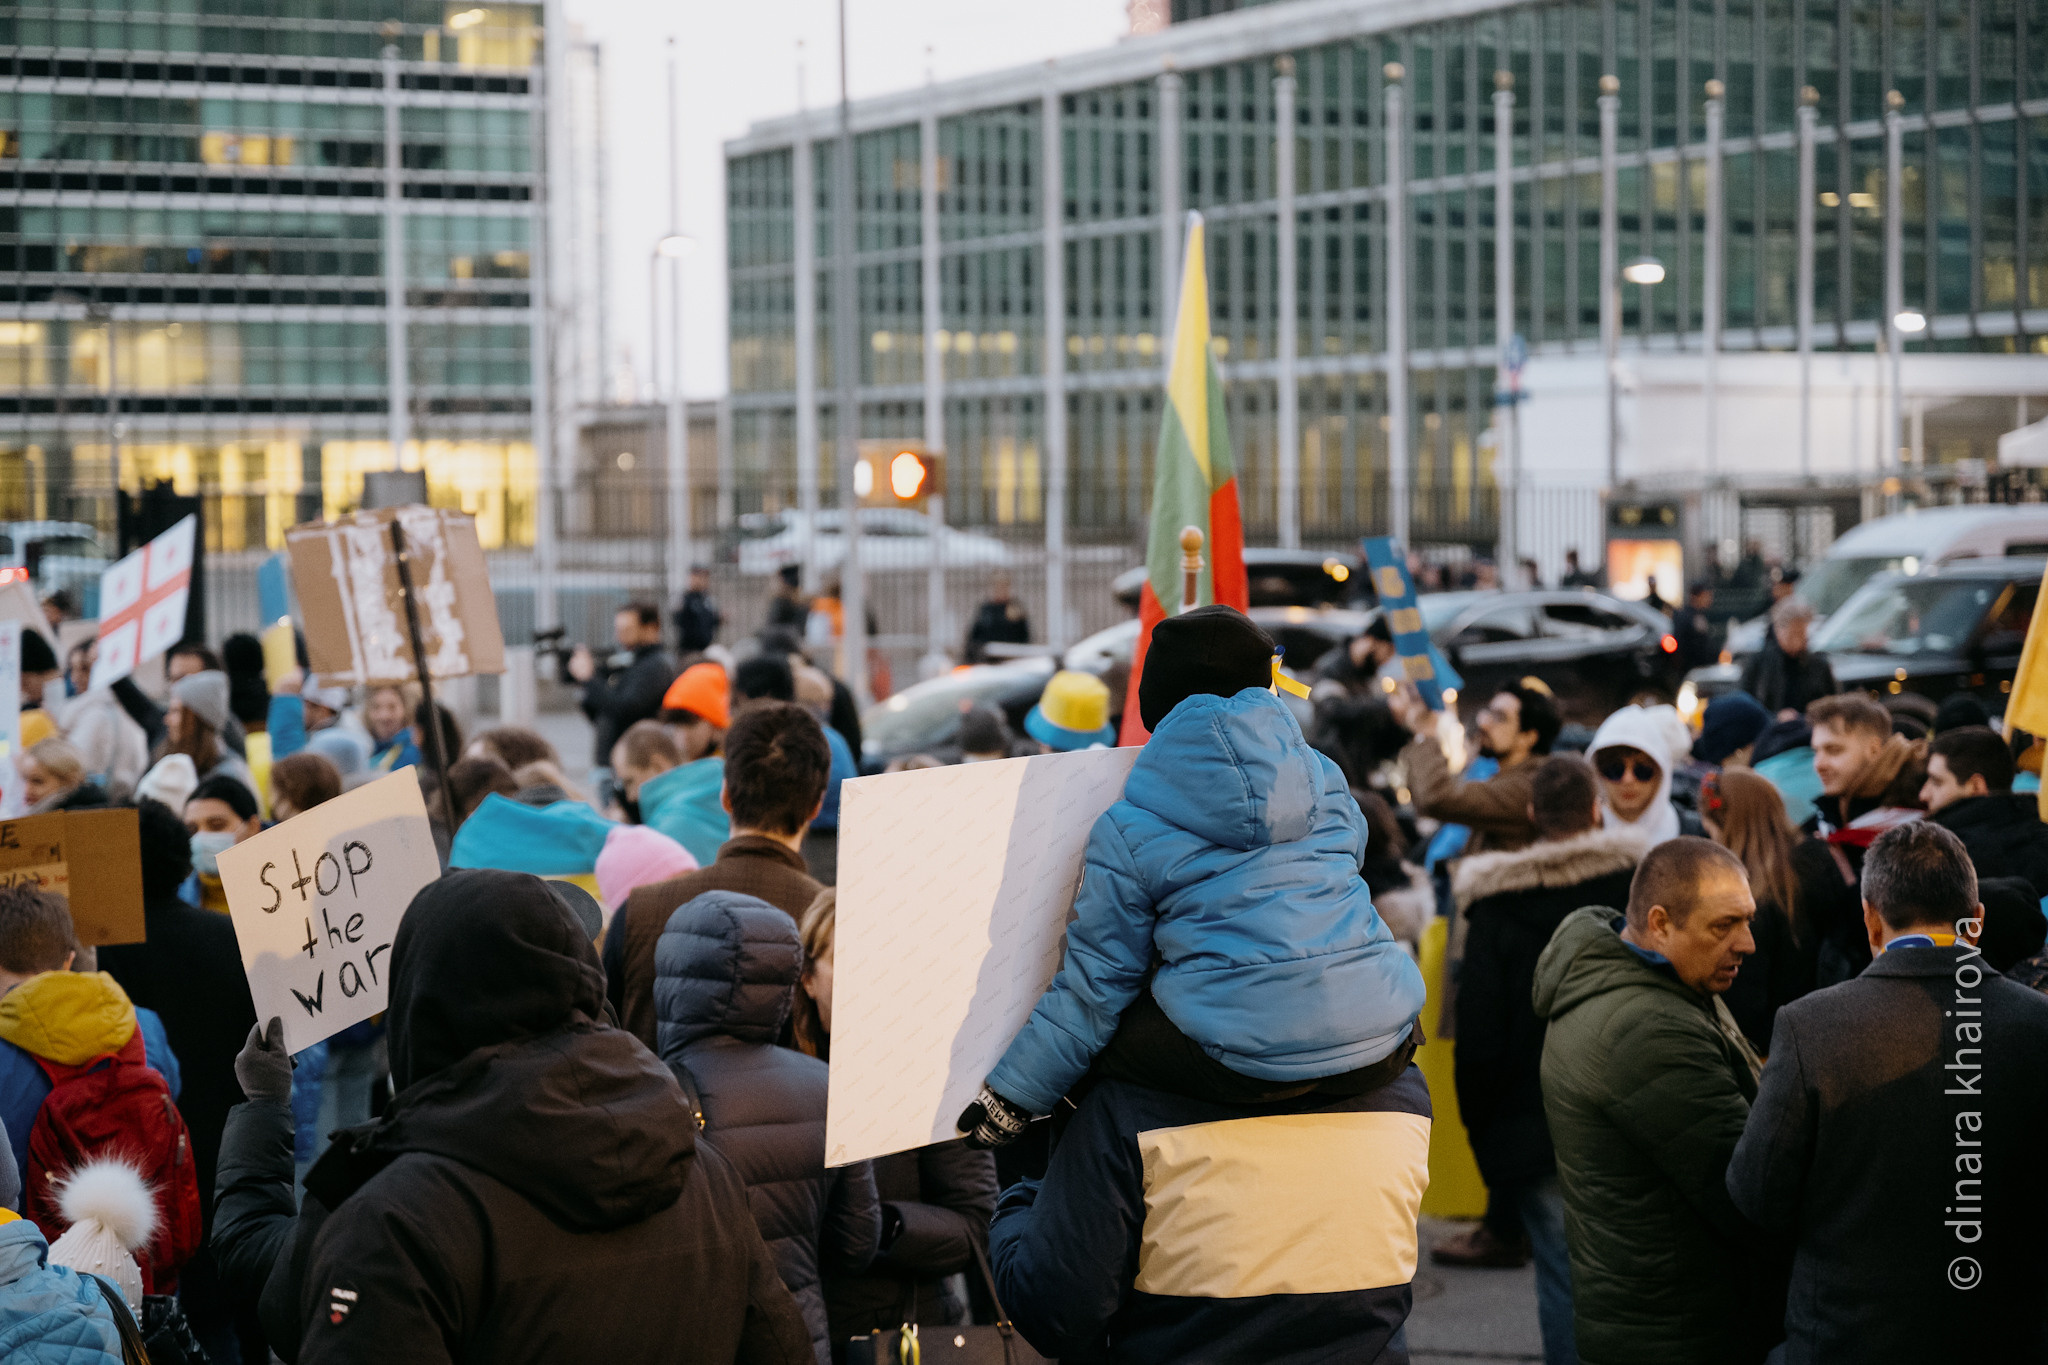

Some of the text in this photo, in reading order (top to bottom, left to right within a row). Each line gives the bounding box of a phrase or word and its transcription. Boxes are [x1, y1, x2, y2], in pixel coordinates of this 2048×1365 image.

[302, 908, 364, 959] the
[290, 943, 391, 1018] war
[982, 1094, 1024, 1131] NEW YO
